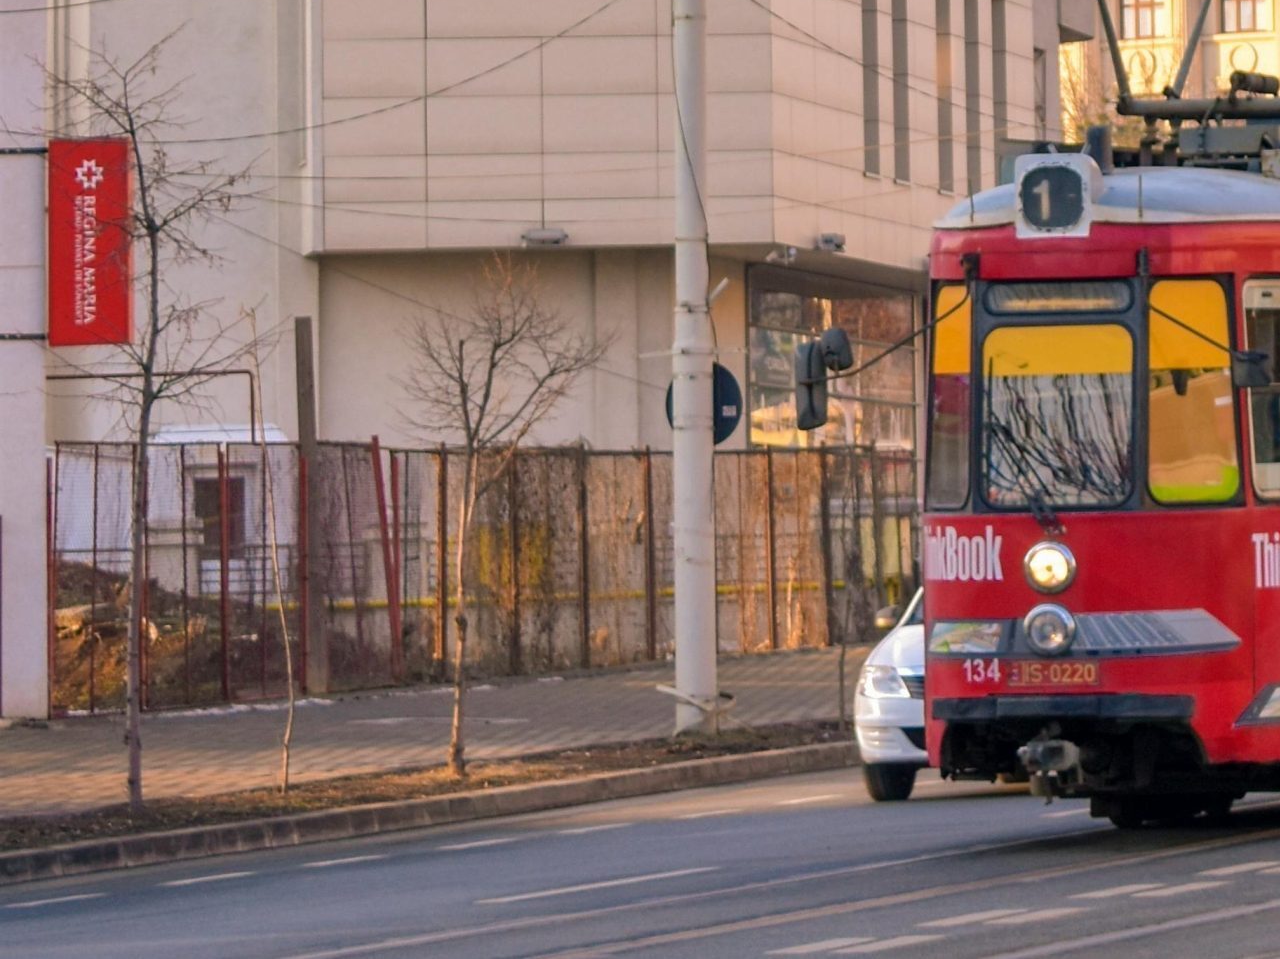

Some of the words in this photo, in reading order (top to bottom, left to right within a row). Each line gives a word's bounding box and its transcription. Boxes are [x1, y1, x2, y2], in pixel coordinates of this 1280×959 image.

[1032, 179, 1050, 221] 1
[83, 194, 97, 260] REGINA
[83, 266, 97, 323] MARIA
[963, 658, 1000, 682] 134
